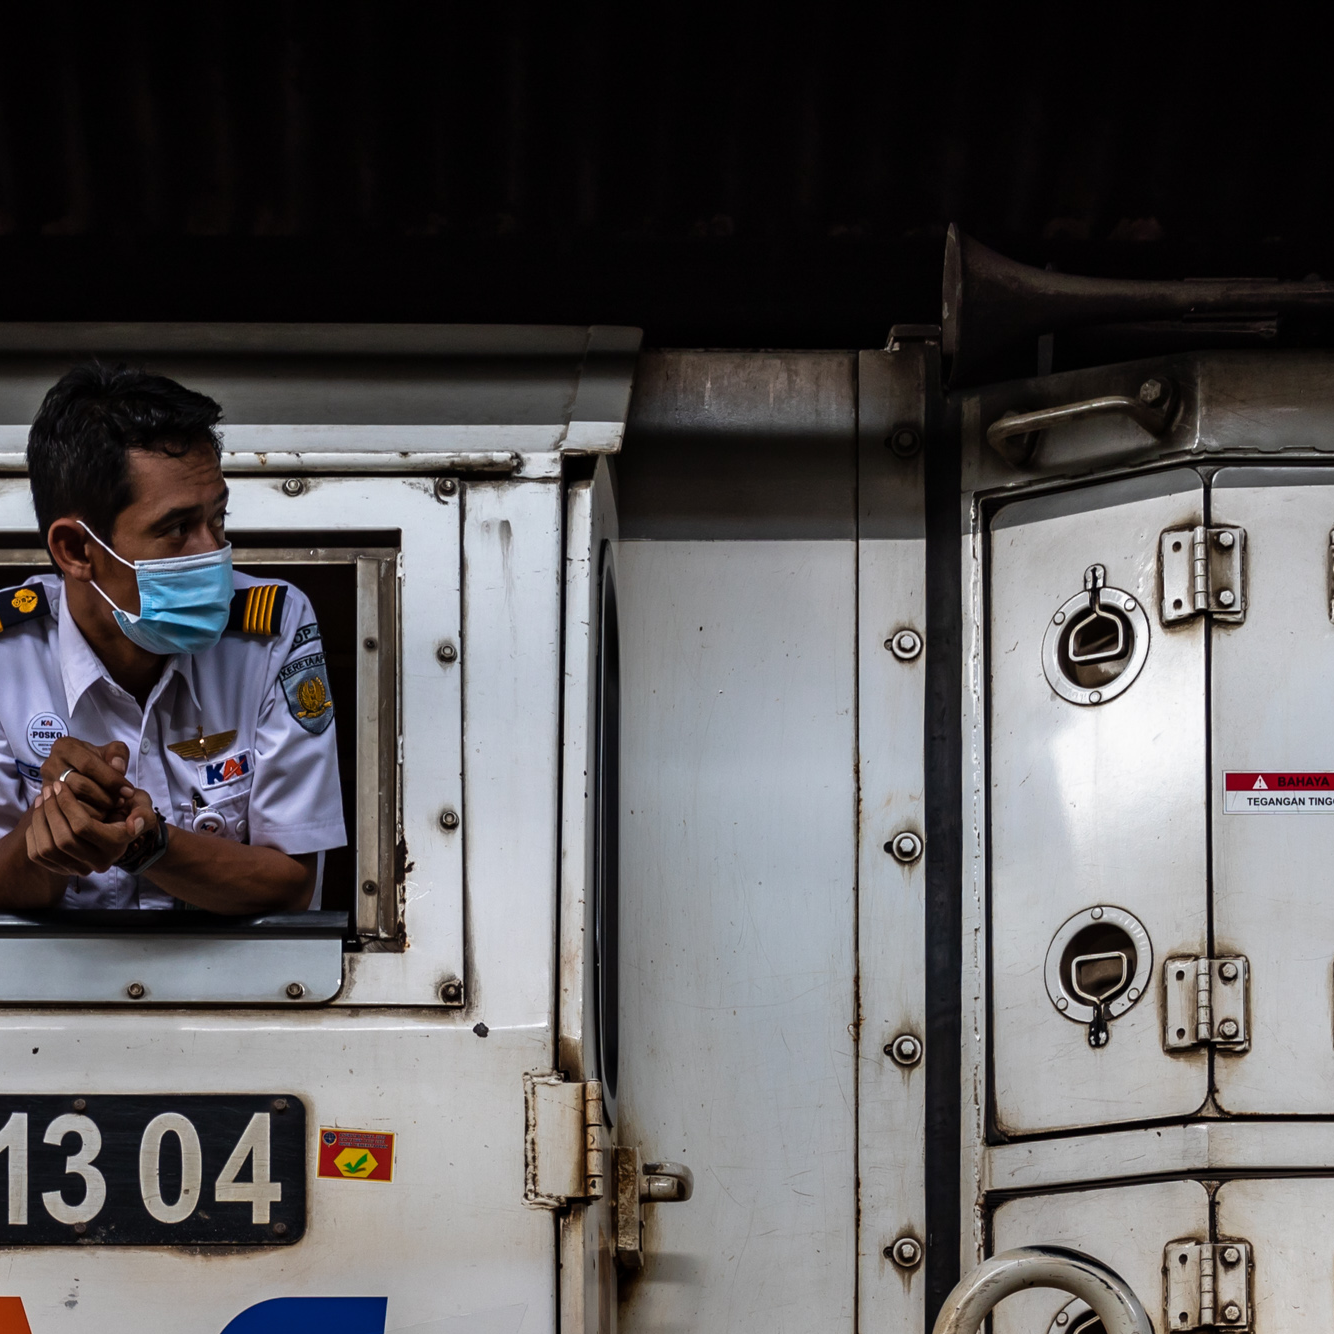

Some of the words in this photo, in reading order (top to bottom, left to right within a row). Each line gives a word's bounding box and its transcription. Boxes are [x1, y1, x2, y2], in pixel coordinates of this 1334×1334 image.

[282, 657, 315, 677] KERETA
[32, 731, 63, 739] POSKO
[205, 754, 249, 785] KAI
[1277, 776, 1330, 787] BAHAYA
[1247, 797, 1306, 807] TEGANGAN
[139, 1112, 282, 1224] 04
